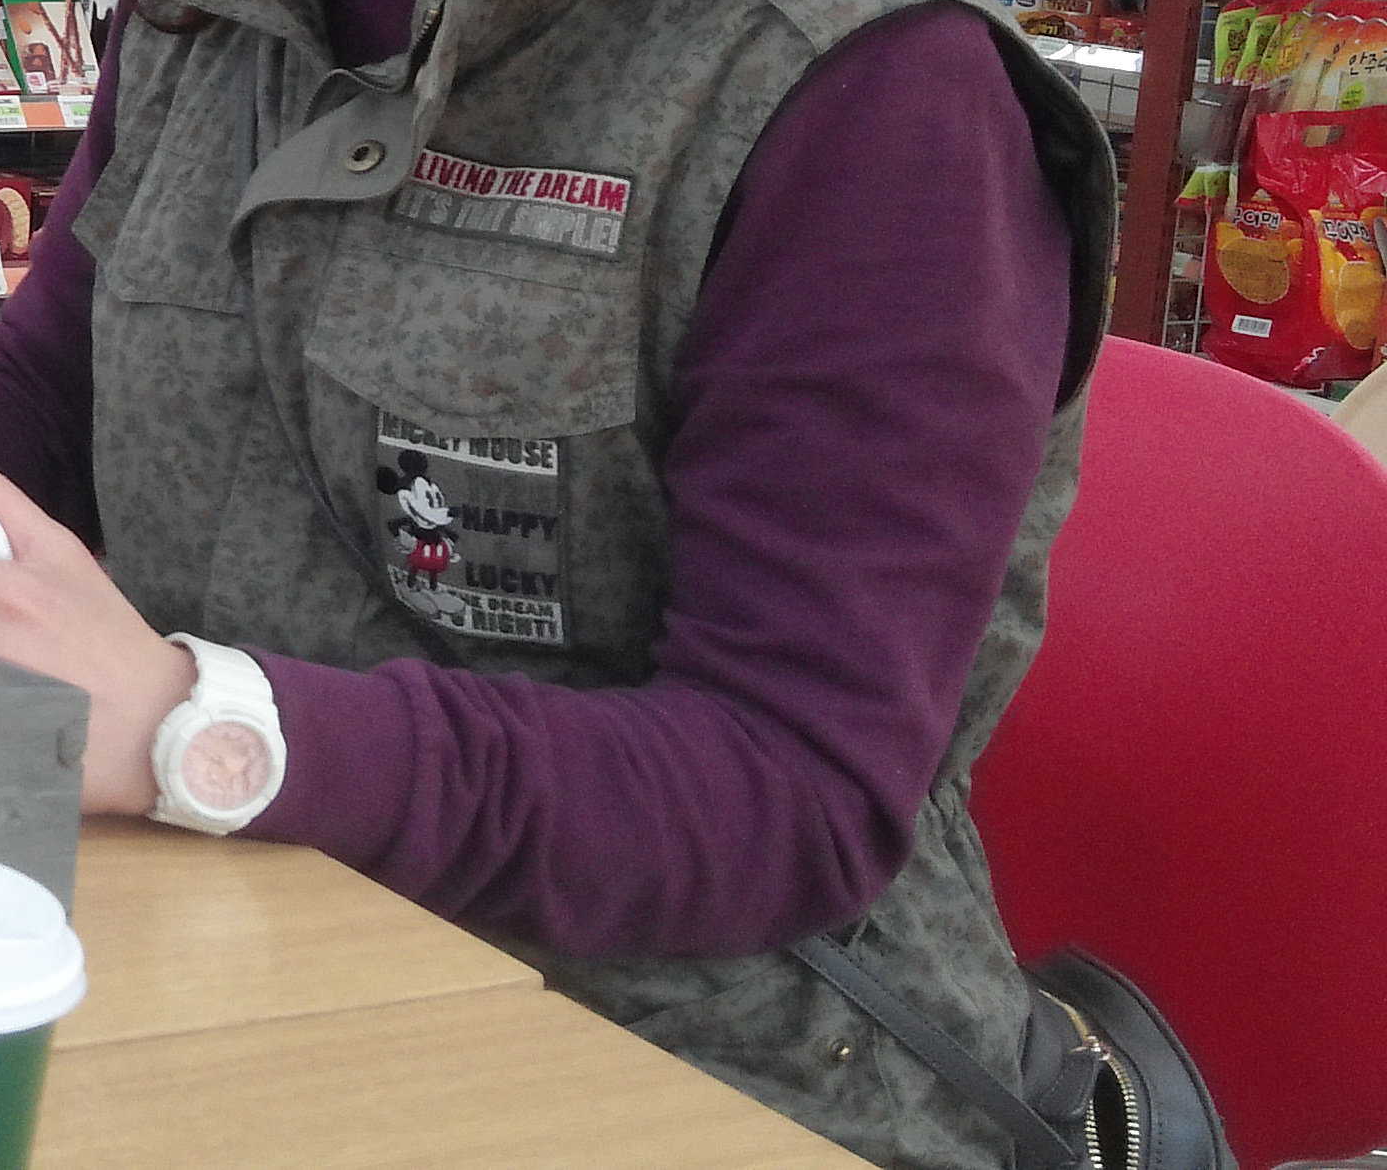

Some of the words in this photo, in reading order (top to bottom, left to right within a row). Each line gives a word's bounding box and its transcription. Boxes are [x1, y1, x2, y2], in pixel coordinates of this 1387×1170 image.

[413, 152, 495, 196] LIVING
[498, 168, 535, 197] THE
[535, 171, 627, 214] DREAM
[510, 203, 622, 254] SIMPLE!
[462, 502, 558, 539] HAPPY
[464, 561, 558, 597] LUCKY
